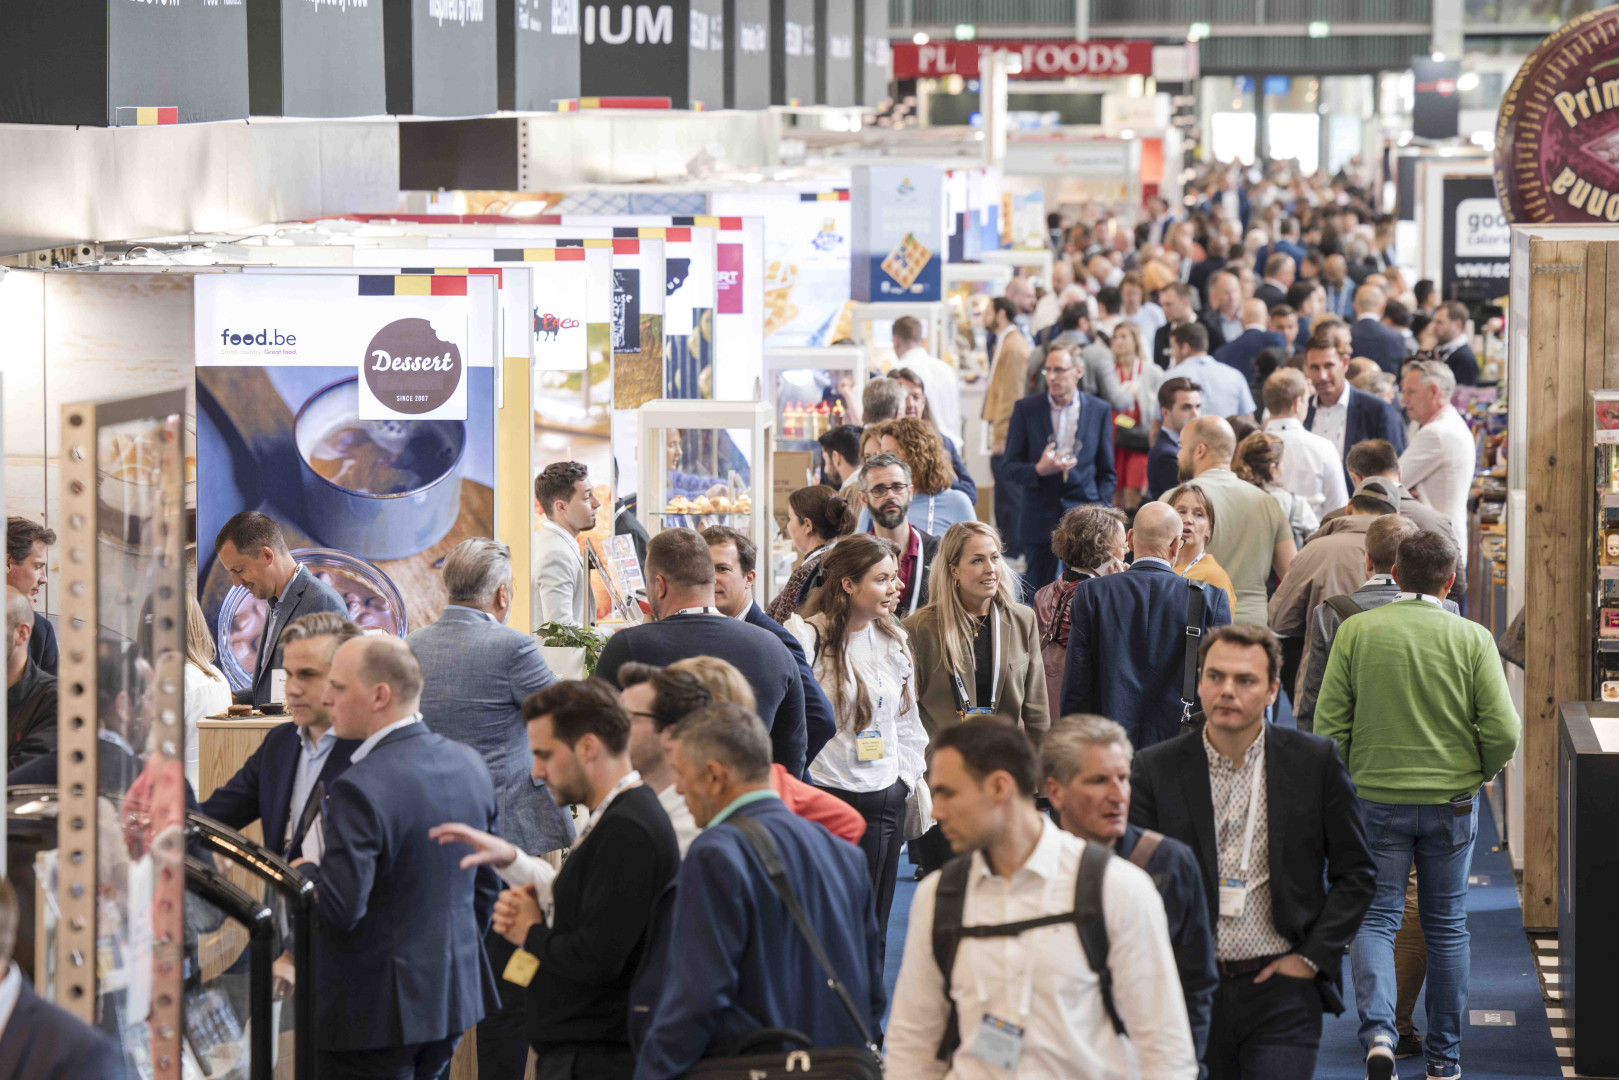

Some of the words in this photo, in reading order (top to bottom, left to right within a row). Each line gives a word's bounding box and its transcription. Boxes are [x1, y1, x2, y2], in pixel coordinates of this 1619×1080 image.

[584, 5, 673, 45] IUM
[220, 328, 297, 346] food.be
[371, 349, 454, 371] Dessert
